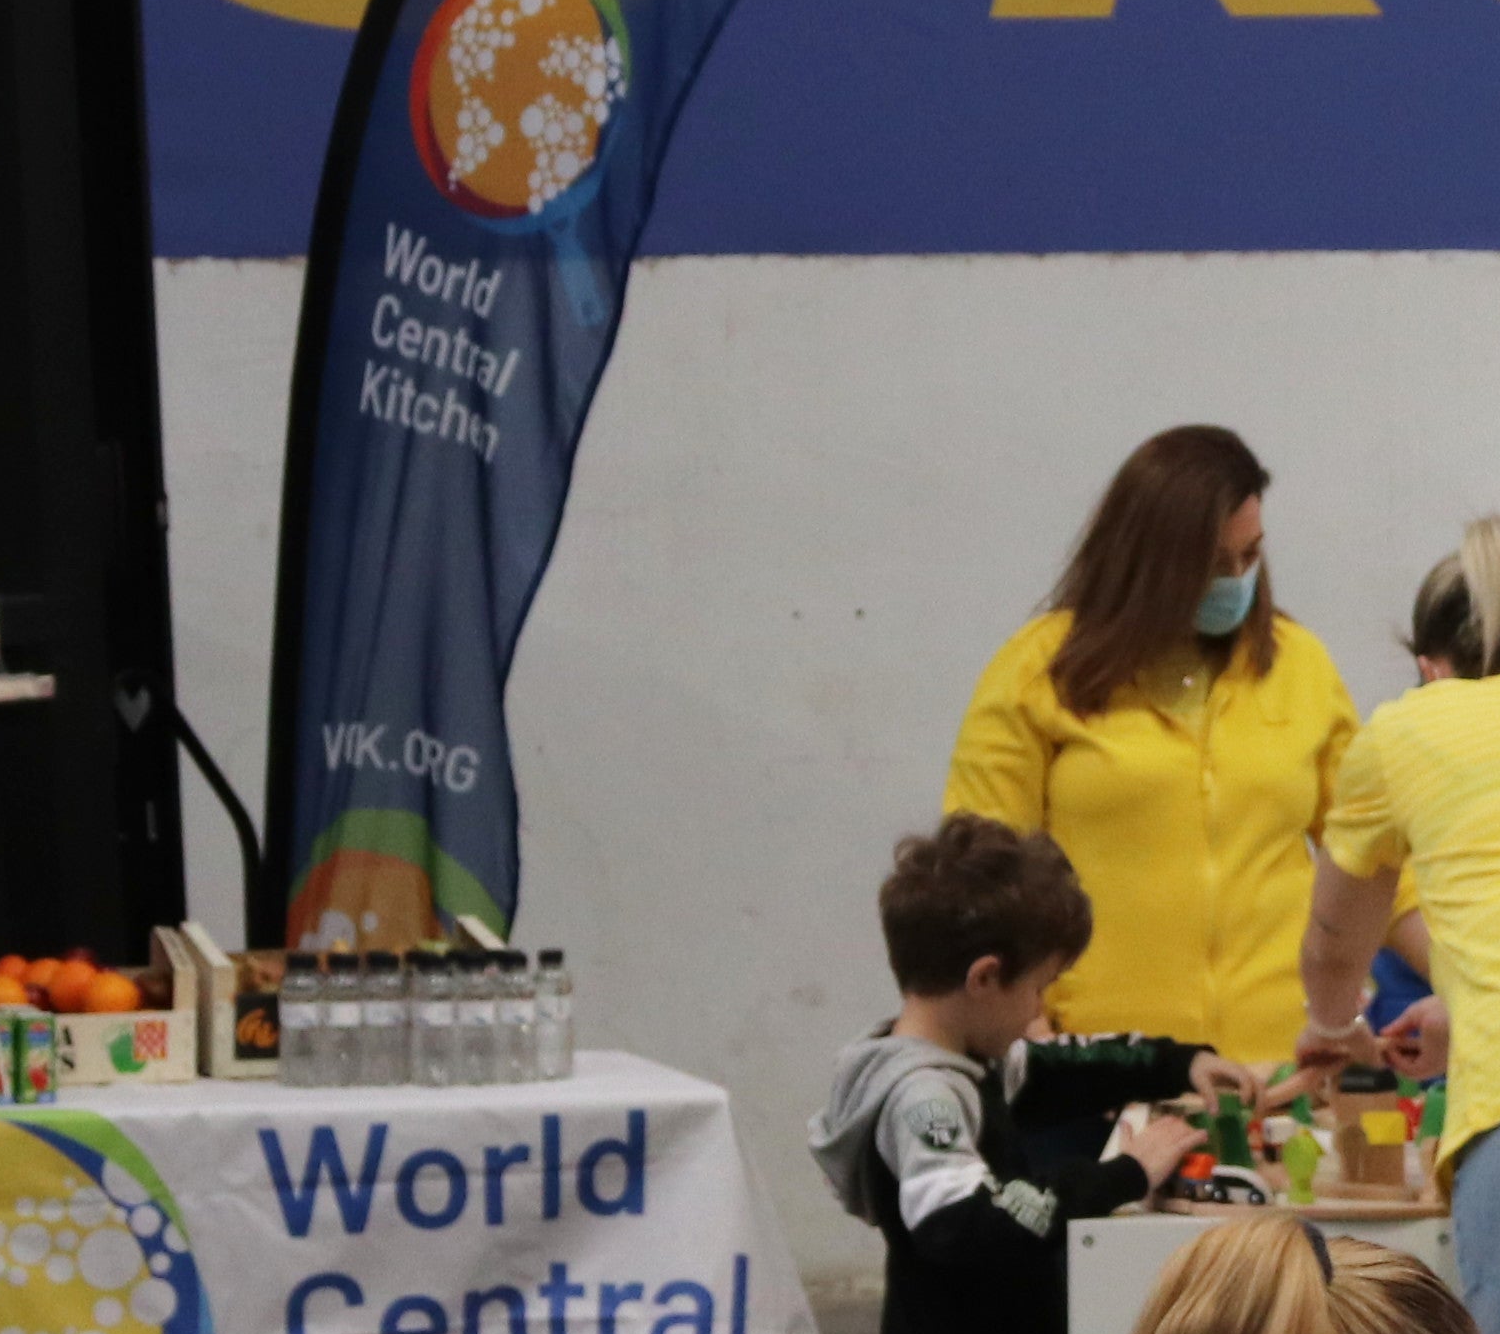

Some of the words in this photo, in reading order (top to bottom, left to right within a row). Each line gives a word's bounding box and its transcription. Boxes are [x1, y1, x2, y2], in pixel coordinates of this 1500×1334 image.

[384, 221, 502, 319] World
[371, 293, 520, 398] Central
[257, 1109, 647, 1238] World
